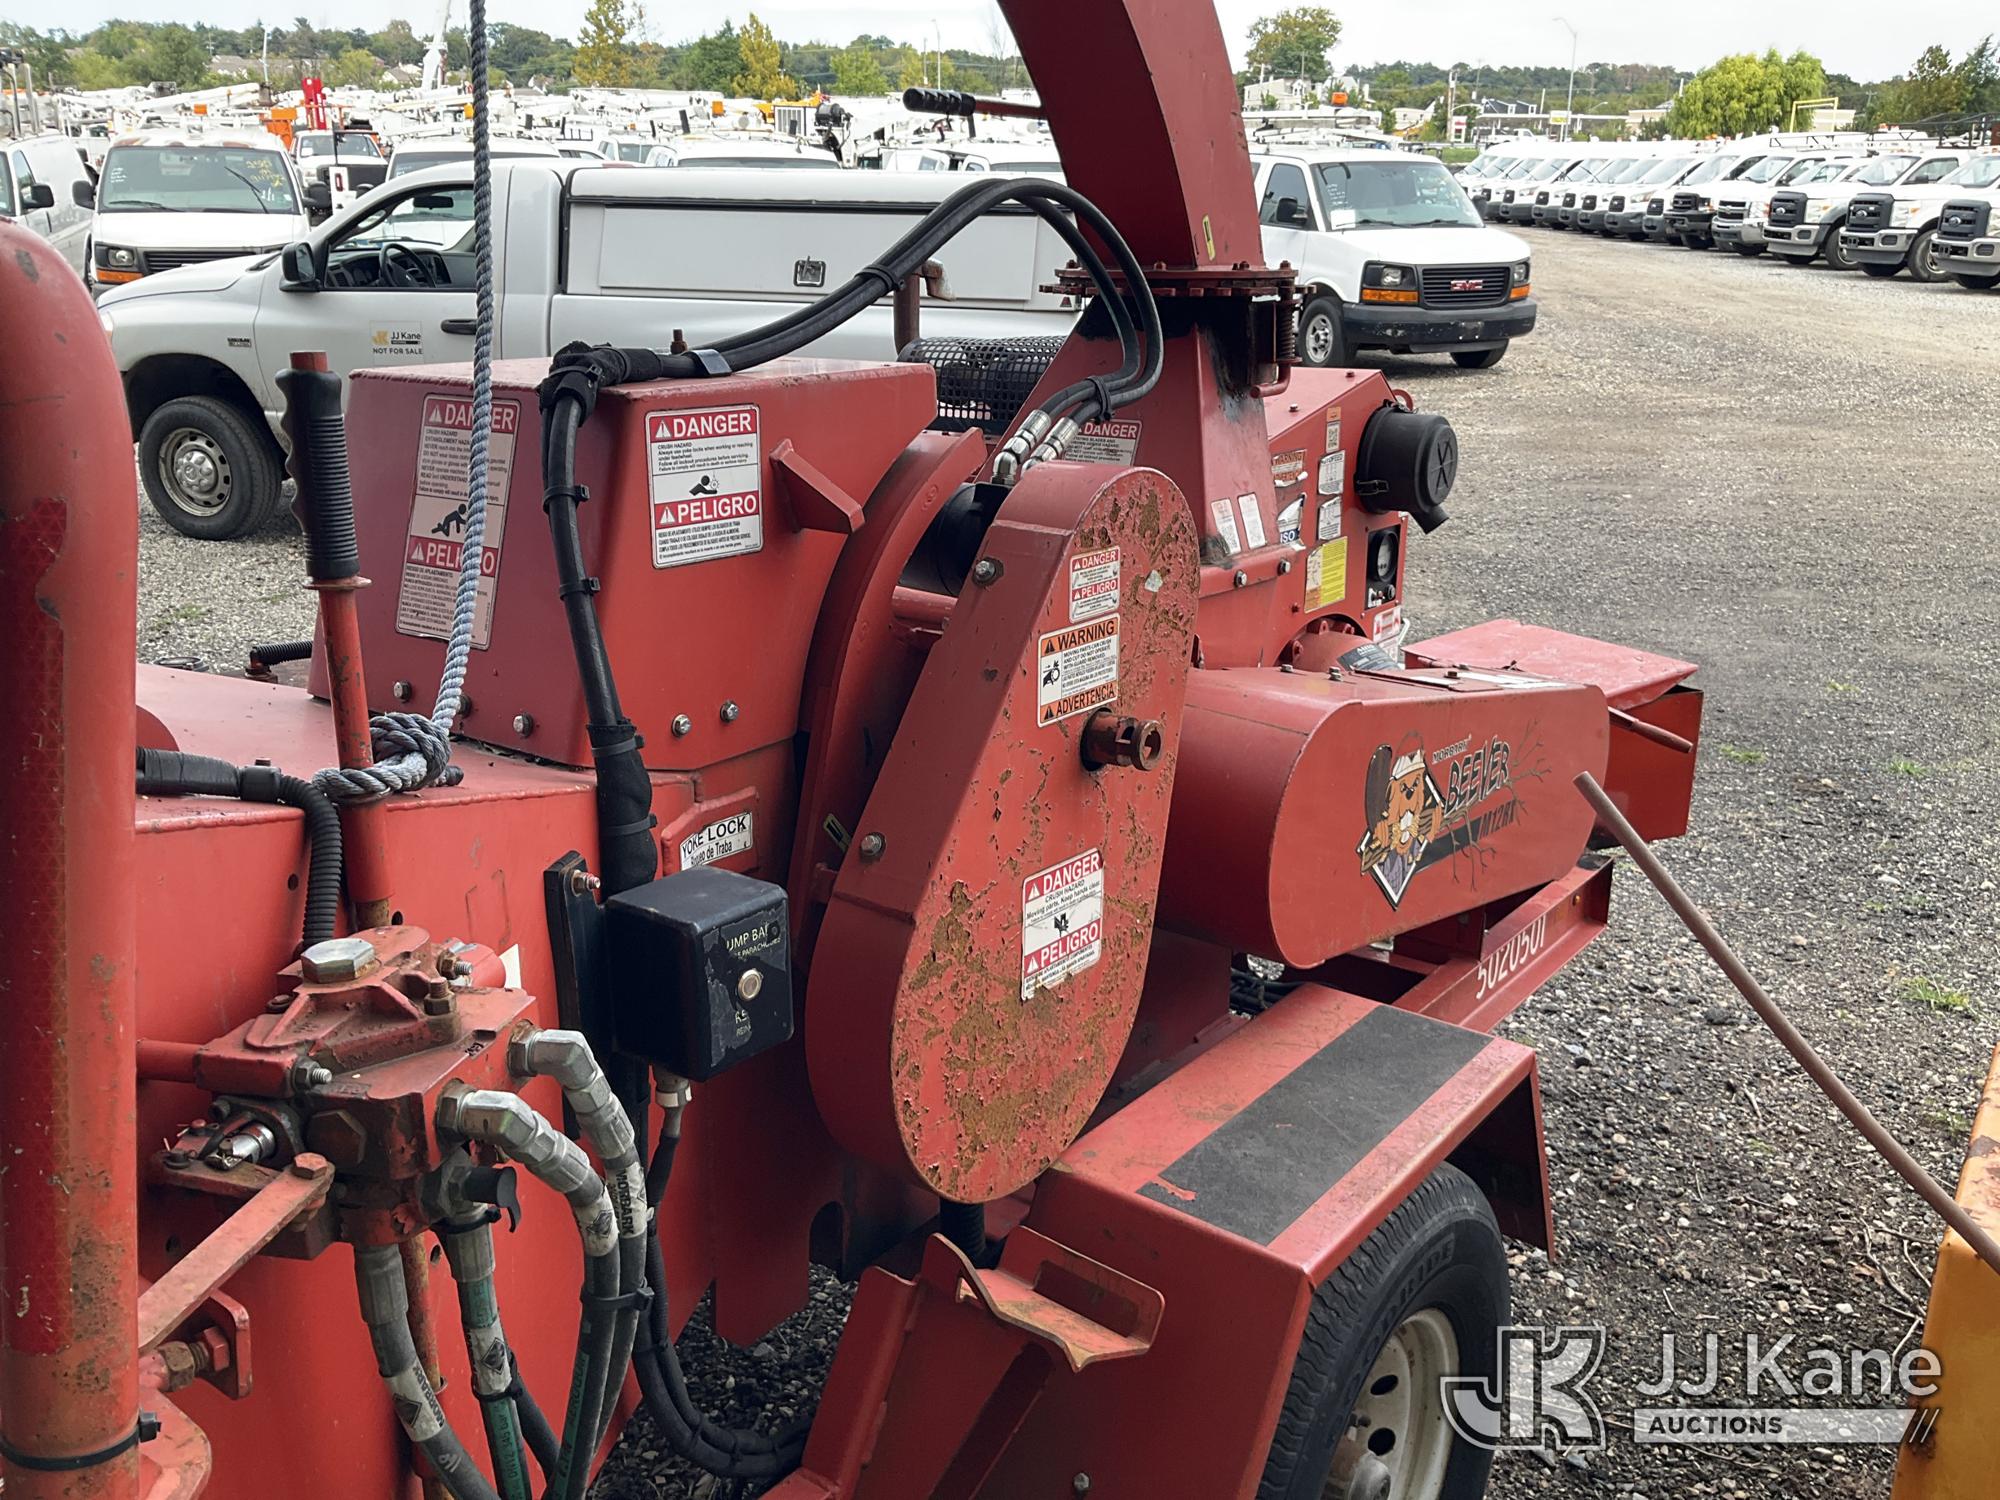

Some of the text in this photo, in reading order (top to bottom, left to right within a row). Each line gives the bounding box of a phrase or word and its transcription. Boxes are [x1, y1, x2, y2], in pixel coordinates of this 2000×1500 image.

[1450, 279, 1483, 291] GMC
[391, 331, 421, 340] JJ Kane
[444, 403, 514, 430] DANER
[673, 412, 751, 437] DANGER
[1084, 422, 1138, 438] DANGER
[677, 494, 756, 522] PELIGRO
[426, 542, 495, 574] PELIO
[1082, 550, 1115, 568] DANGER
[1081, 579, 1116, 598] PELIGRO
[1057, 620, 1113, 650] WARNING
[1056, 682, 1114, 715] ADVERTENCIA
[1444, 735, 1511, 818] BEEVER
[682, 816, 747, 858] YOKE LOCK
[706, 846, 714, 859] de
[715, 840, 732, 856] Traba
[1043, 852, 1099, 894] DANGER
[1064, 879, 1084, 893] HAZARD
[1026, 906, 1044, 920] Moving
[726, 932, 750, 952] UMP
[1040, 921, 1098, 969] PELIGRO
[616, 1169, 634, 1235] MORBARK
